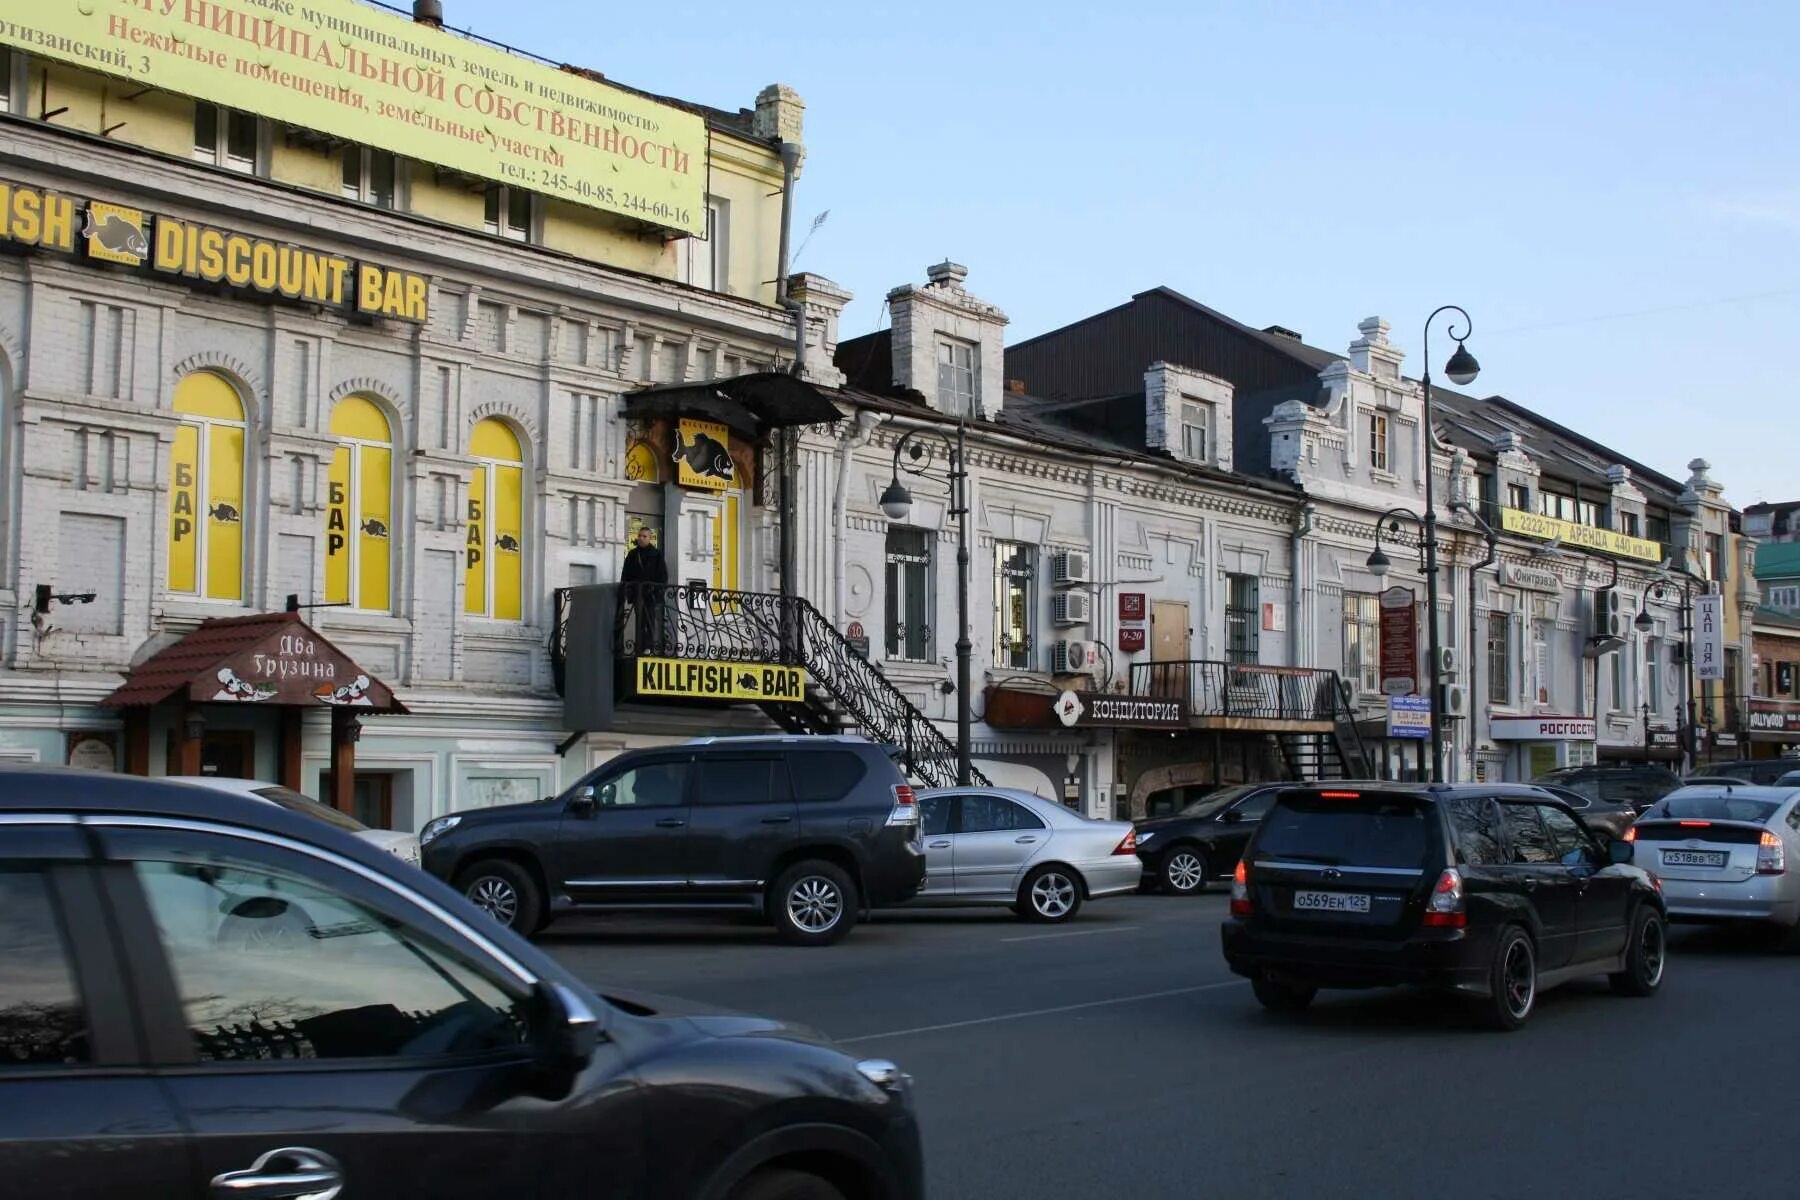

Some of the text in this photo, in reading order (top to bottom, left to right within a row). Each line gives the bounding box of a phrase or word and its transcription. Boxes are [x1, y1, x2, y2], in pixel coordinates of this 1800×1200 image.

[107, 14, 566, 168] Нежилые помещения, земельные участки
[138, 55, 151, 74] 3
[301, 7, 456, 68] муниципальных
[463, 57, 519, 89] земель
[524, 80, 534, 94] и
[539, 84, 660, 133] недвижимости»
[454, 82, 690, 175] СОБСТВЕННОСТИ
[499, 160, 690, 225] тел.: 245-40-85, 244-60-16
[0, 183, 427, 321] ISH DISCOUNT BAR
[174, 463, 193, 541] БАР
[328, 482, 345, 556] БАР
[467, 499, 481, 569] БАР
[1520, 515, 1561, 539] 2222-777
[1569, 526, 1608, 548] АРЕНДА
[1614, 535, 1631, 553] 440
[1122, 631, 1142, 641] 9-20
[642, 662, 800, 698] KILLFISH BAR
[1092, 700, 1180, 721] КОНДИТОРИЯ
